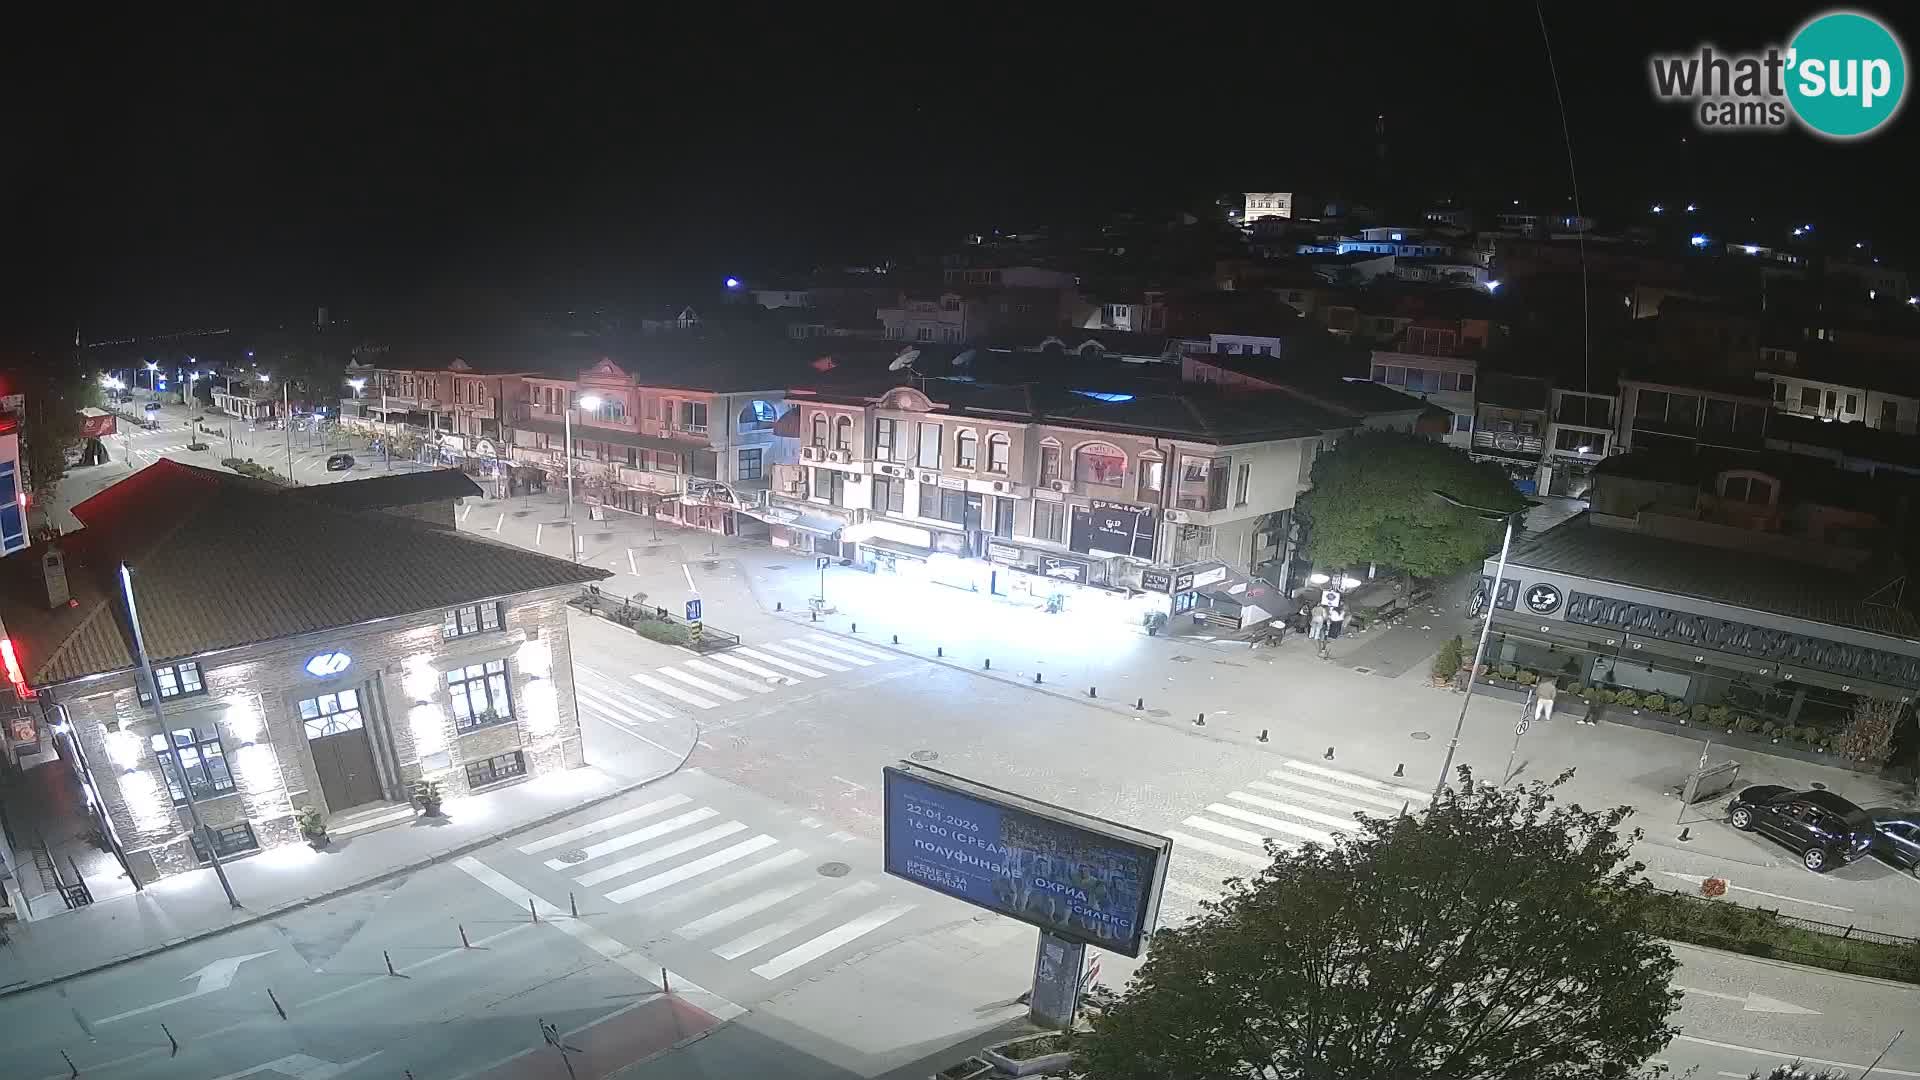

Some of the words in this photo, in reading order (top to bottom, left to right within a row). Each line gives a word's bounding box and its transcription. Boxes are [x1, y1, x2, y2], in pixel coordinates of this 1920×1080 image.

[906, 803, 978, 832] 22.04.2026
[907, 818, 947, 837] 16:00
[1074, 905, 1129, 927] СИЛЕКС
